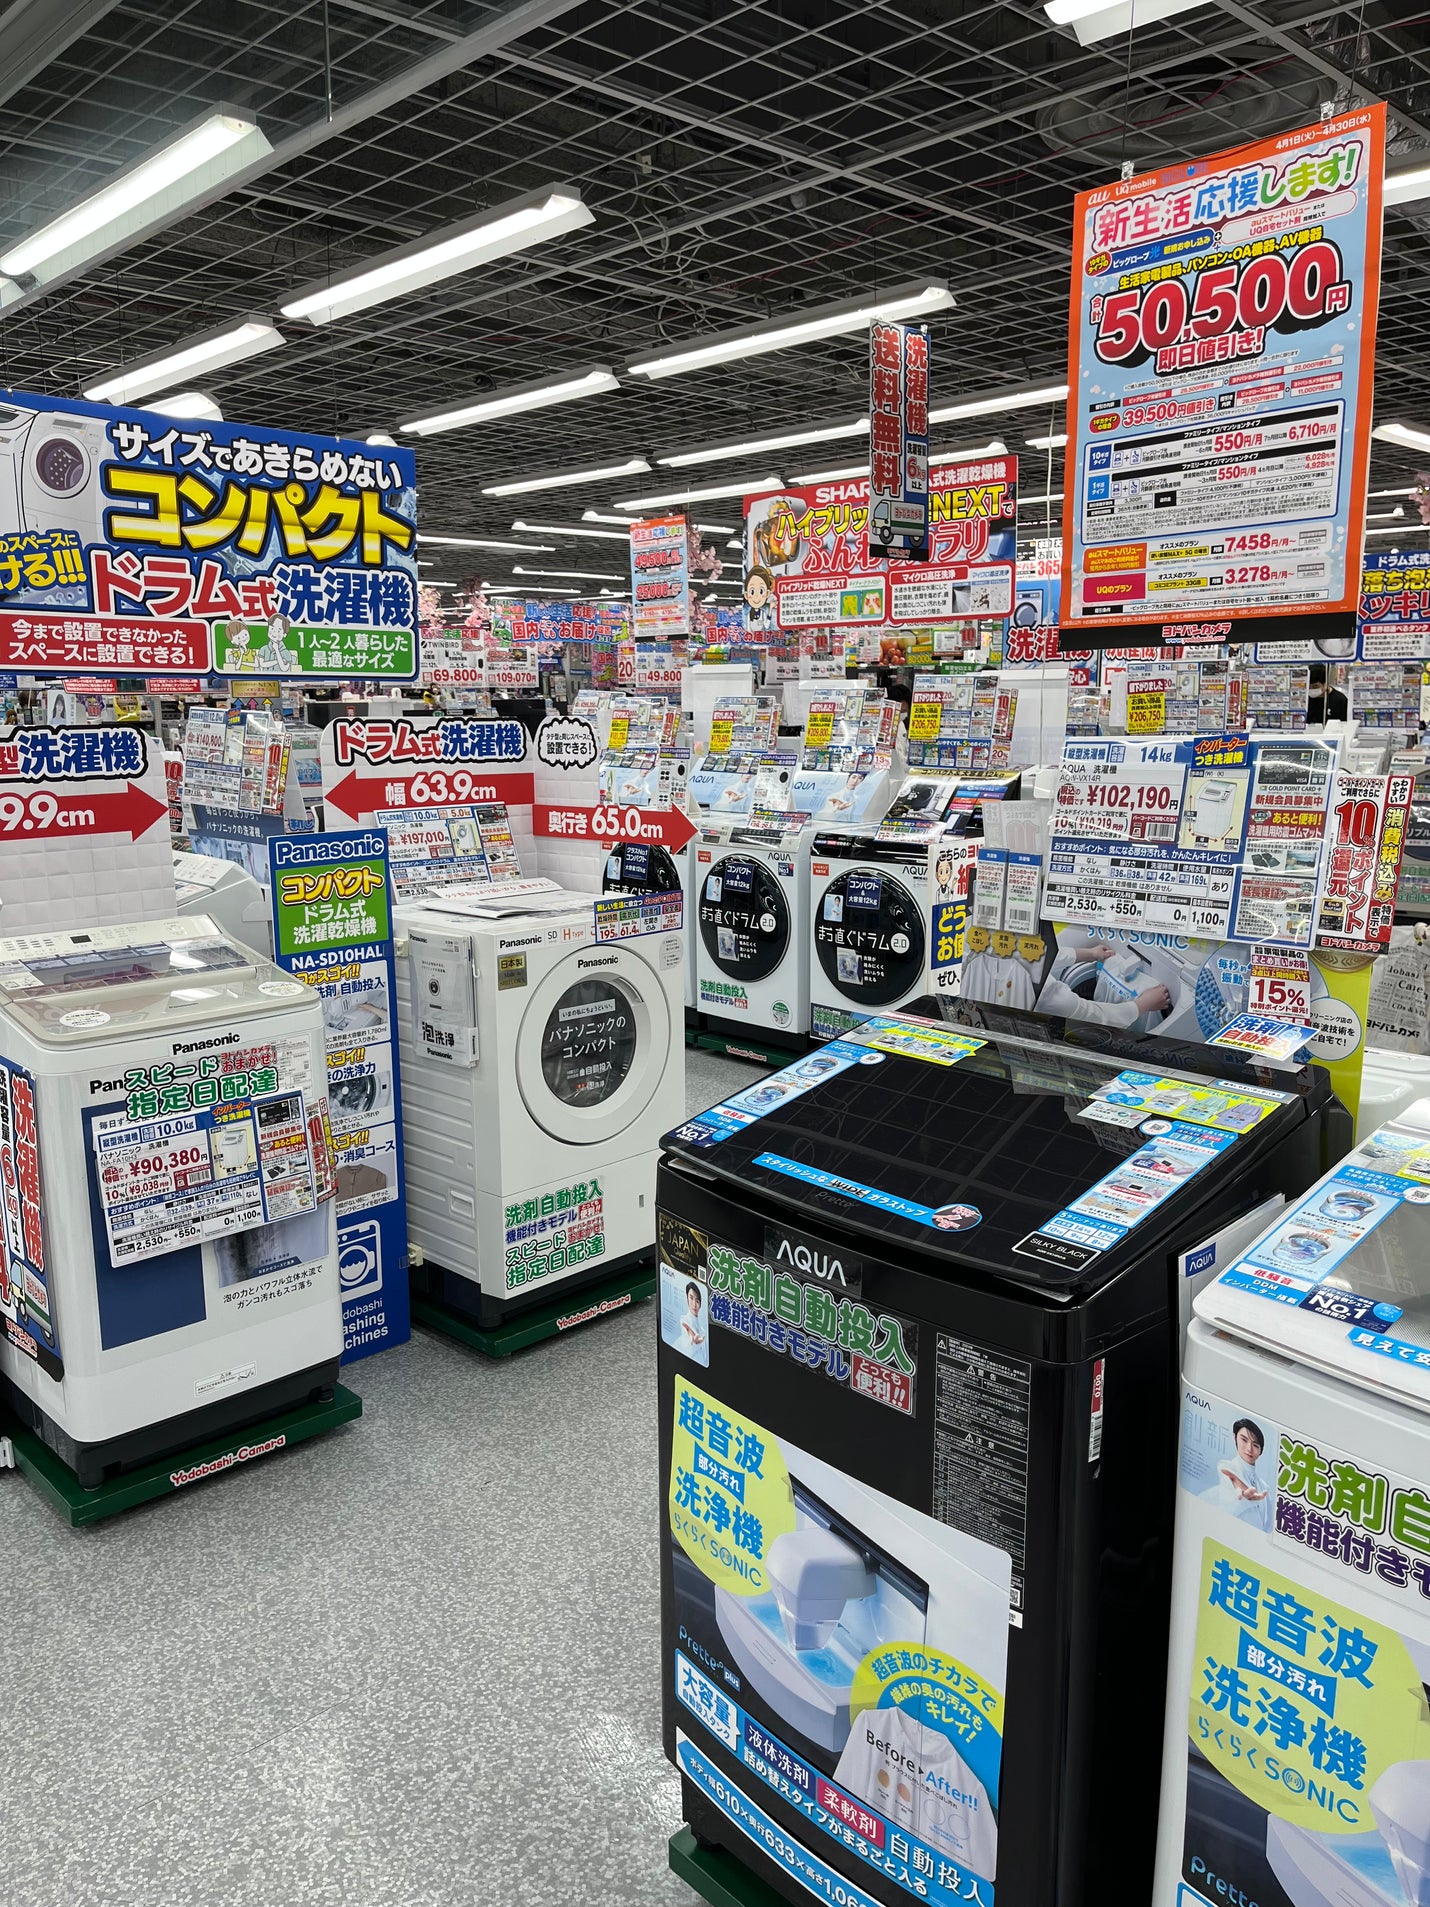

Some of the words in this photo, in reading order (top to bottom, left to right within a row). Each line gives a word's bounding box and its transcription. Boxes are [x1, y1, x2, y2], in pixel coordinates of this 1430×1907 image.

[1097, 148, 1357, 248] 新生活応援します!
[1091, 296, 1102, 323] 合計
[1096, 245, 1349, 361] 50,500円
[1157, 328, 1264, 370] 即日値引き!
[906, 334, 928, 436] 洗濯機
[873, 326, 903, 497] 送料無料
[1123, 399, 1215, 428] 39,500円値引き
[1214, 430, 1263, 452] 550円/月
[1288, 423, 1337, 441] 6,710円/月
[112, 424, 402, 488] サイズであきらめない
[906, 459, 927, 481] 6kg
[816, 482, 871, 503] SHAR
[929, 462, 1006, 488] 式洗濯乾燥機
[1217, 465, 1257, 482] 550円/月
[109, 468, 411, 562] コンパクト
[92, 553, 413, 626] ドラム式洗濯機
[1097, 584, 1133, 595] UQのプラン
[11, 619, 187, 644] 今まで設置できなかった
[1162, 623, 1231, 638] ヨドバシカメラ
[9, 641, 194, 665] スペースに設置できる!
[312, 651, 394, 669] 最適なサイズ
[433, 669, 483, 682] 69,800円
[496, 672, 537, 683] 109,070円
[648, 670, 682, 681] 49,800
[0, 731, 140, 775] 型洗濯機
[336, 720, 522, 762] ドラム式洗濯機
[547, 741, 592, 755] 設置できる!
[1140, 745, 1173, 764] 14kg
[1194, 737, 1248, 754] インバーター
[1060, 764, 1087, 774] AQUA
[1194, 751, 1245, 767] つき洗濯機
[385, 782, 407, 806] 幅
[410, 770, 497, 803] 63.9cm
[690, 775, 715, 784] AQUA
[1086, 784, 1179, 811] ¥102,190円
[1255, 794, 1324, 806] 新規会員募集中
[548, 809, 588, 834] 奥行き
[591, 808, 663, 838] 65.0cm
[1272, 812, 1323, 826] あると便利!
[276, 833, 385, 865] Panasonic
[400, 831, 450, 846] ¥197,010円
[768, 851, 791, 862] AQUA
[1374, 807, 1407, 901] 消費税込み
[727, 864, 751, 874] コンパクト
[281, 866, 384, 905] コンパクト
[849, 880, 879, 890] コンパクト
[1211, 881, 1229, 893] あり
[1345, 849, 1376, 934] ポイント
[303, 899, 367, 925] ドラム式
[701, 907, 759, 930] まっ直ぐドラム
[762, 917, 774, 928] 2.0
[293, 918, 378, 946] 洗濯乾燥機
[500, 935, 542, 949] Panasonic
[547, 931, 558, 940] SD
[563, 928, 571, 941] H
[818, 925, 890, 951] まっ直ぐドラム
[893, 938, 907, 949] 2.0
[1321, 937, 1381, 952] ヨドバシカメラ
[291, 944, 383, 971] NA-SD10HAL
[501, 957, 523, 969] 日本製
[577, 955, 619, 969] Panasonic
[340, 975, 385, 995] 自動投入
[1254, 979, 1306, 1007] 15%
[549, 1016, 626, 1043] パナソニックの
[1232, 1016, 1284, 1036] 洗剤
[172, 1032, 241, 1057] Panasonic
[220, 1044, 271, 1061] ヨドバシカメラ
[562, 1036, 616, 1059] コンパクト
[125, 1055, 218, 1090] スピード
[221, 1051, 279, 1074] おまかせ!
[126, 1067, 280, 1121] 指定日配達
[157, 1119, 195, 1137] 10.0kg
[129, 1147, 208, 1177] ¥90,380円
[761, 1156, 828, 1184] スタイリッシュな
[867, 1192, 930, 1217] ガラストップ
[505, 1178, 603, 1229] 洗剤自動投入
[506, 1209, 578, 1245] 機能付きモデル
[506, 1229, 568, 1266] スピード
[507, 1234, 606, 1290] 指定日配達
[1188, 1252, 1214, 1272] AQUA
[776, 1240, 847, 1287] AQUA
[223, 1265, 323, 1304] 泡の力とパワフル立体水流で
[236, 1280, 313, 1310] ガンコ汚れもスゴ落ち
[1251, 1279, 1278, 1291] DDM
[556, 1294, 632, 1331] Yodobashi-Camera
[709, 1246, 915, 1375] 洗剤自動投入
[1308, 1294, 1368, 1320] No.1
[342, 1311, 386, 1335] ashing
[345, 1325, 389, 1350] chines
[709, 1293, 851, 1382] 機能付きモデル
[860, 1359, 902, 1385] とっても
[854, 1368, 907, 1407] 便利!!
[1185, 1392, 1212, 1411] AQUA
[679, 1390, 766, 1481] 超音波
[170, 1435, 286, 1487] Yodobashi-Camera
[698, 1452, 741, 1494] 部分汚れ
[674, 1465, 763, 1561] 洗浄機
[674, 1512, 762, 1587] らくらくSONIC
[1207, 1558, 1379, 1690] 超音波
[871, 1648, 998, 1712] 超音波のチカラで
[1247, 1644, 1327, 1703] 部分汚れ
[682, 1665, 734, 1731] 大容量
[890, 1681, 984, 1732] 繊維の奥の汚れも
[682, 1688, 732, 1741] 自動投入タンク
[926, 1701, 977, 1744] キレイ!
[1200, 1655, 1368, 1792] 洗浄機
[866, 1728, 916, 1775] Before
[925, 1770, 979, 1811] After!!
[1198, 1716, 1360, 1824] らくらくSONIC
[743, 1746, 928, 1897] 詰め替えタイプがまるごと入る
[747, 1725, 811, 1790] 液体洗剤
[823, 1784, 878, 1840] 柔軟剤
[889, 1831, 987, 1907] 自動投入
